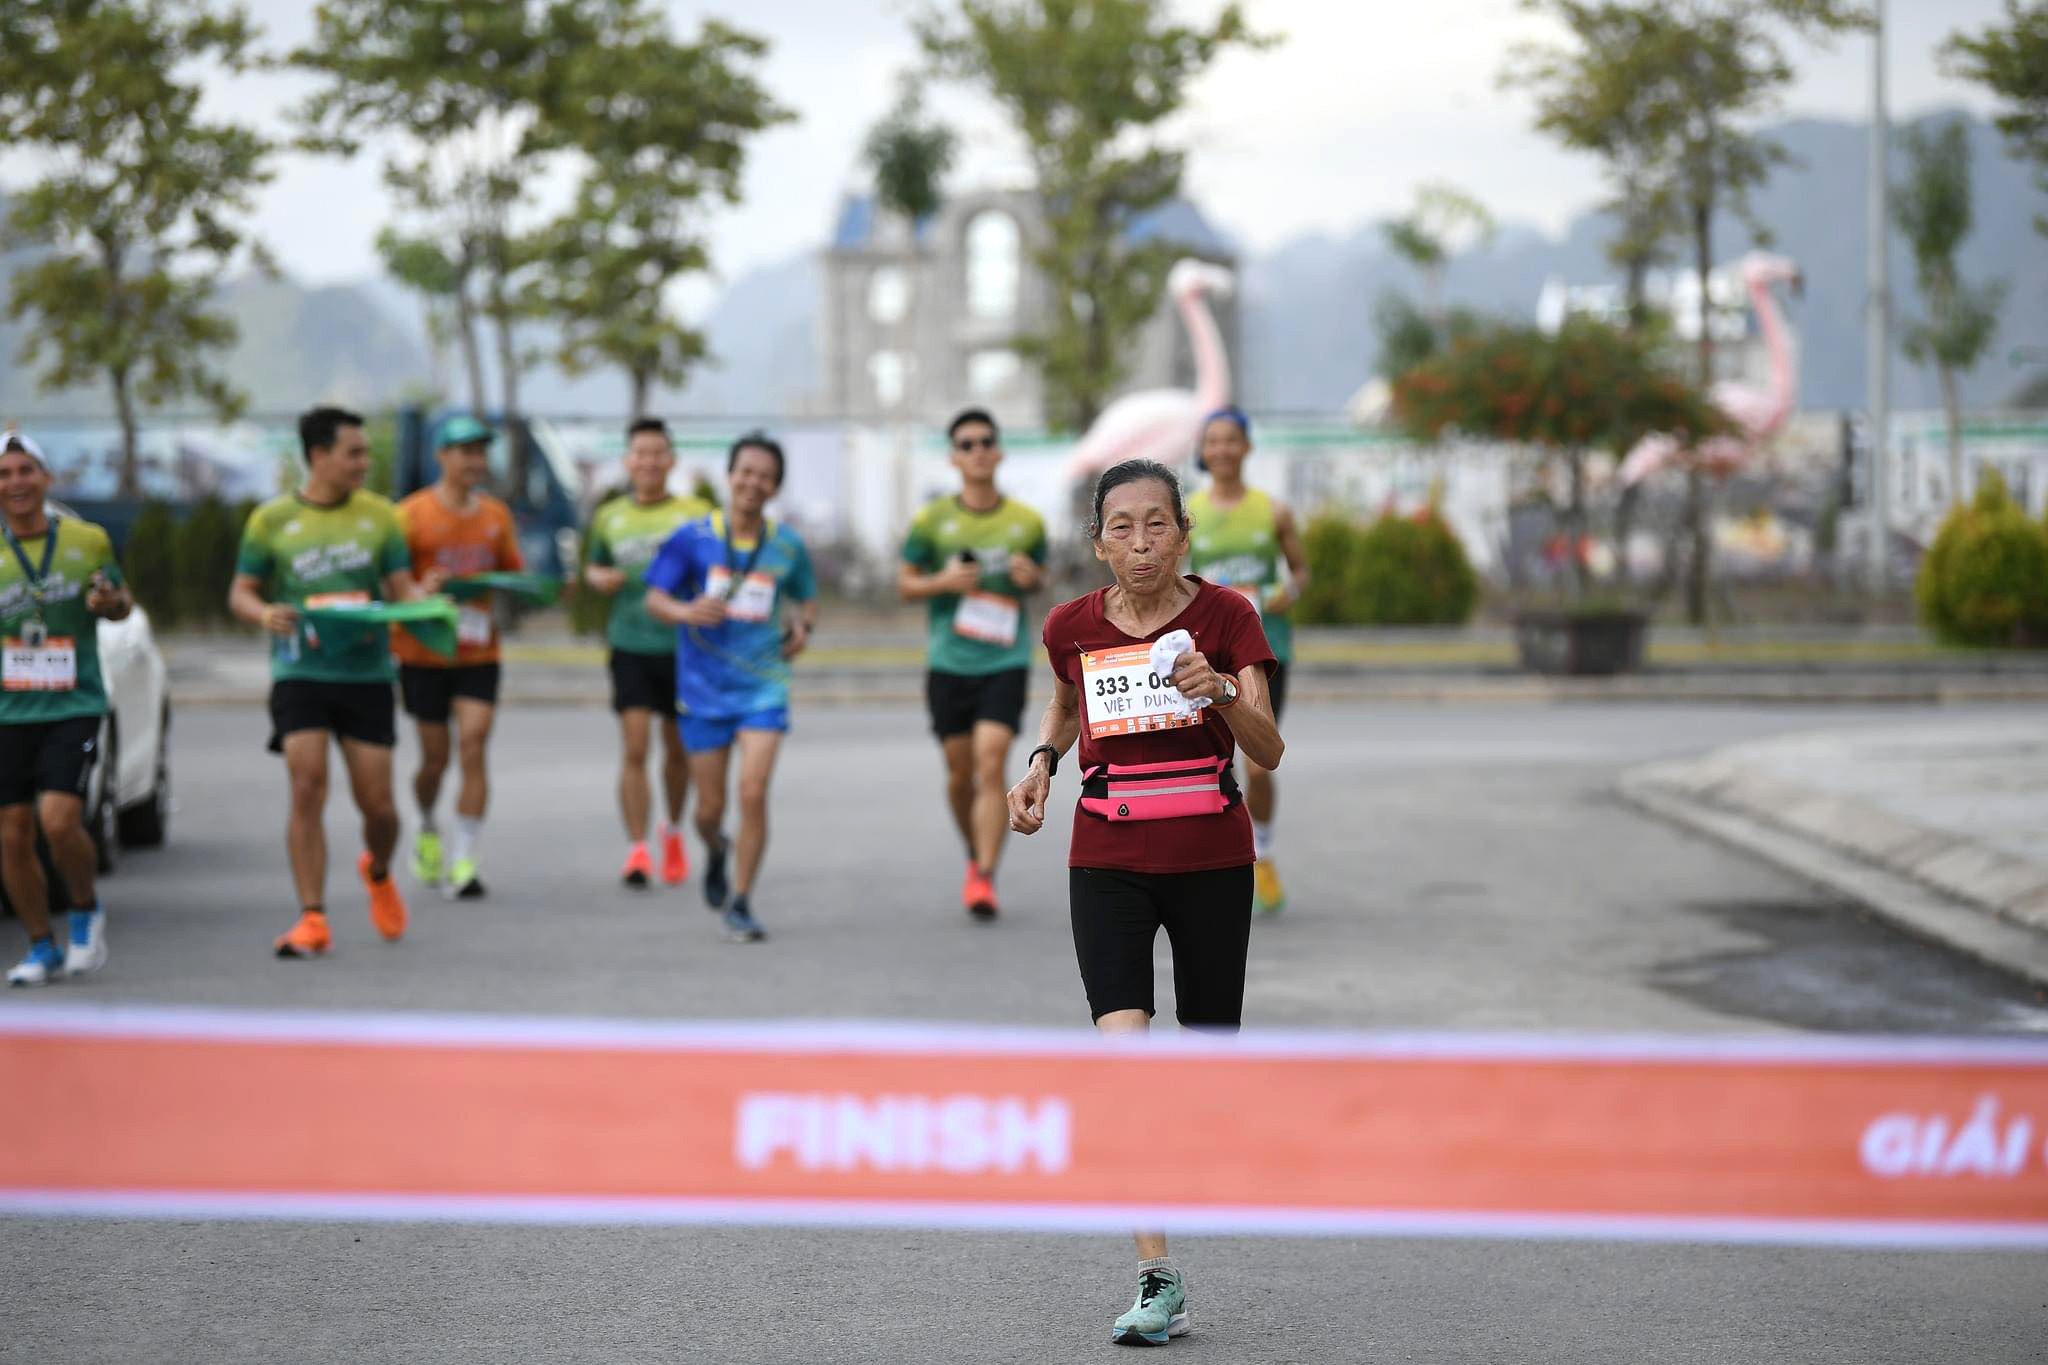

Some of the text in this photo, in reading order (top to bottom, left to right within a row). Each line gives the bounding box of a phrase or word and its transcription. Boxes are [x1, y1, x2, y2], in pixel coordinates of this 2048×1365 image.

[1095, 675, 1130, 697] 333
[1144, 693, 1178, 708] DUN
[736, 1091, 1071, 1173] FINISH
